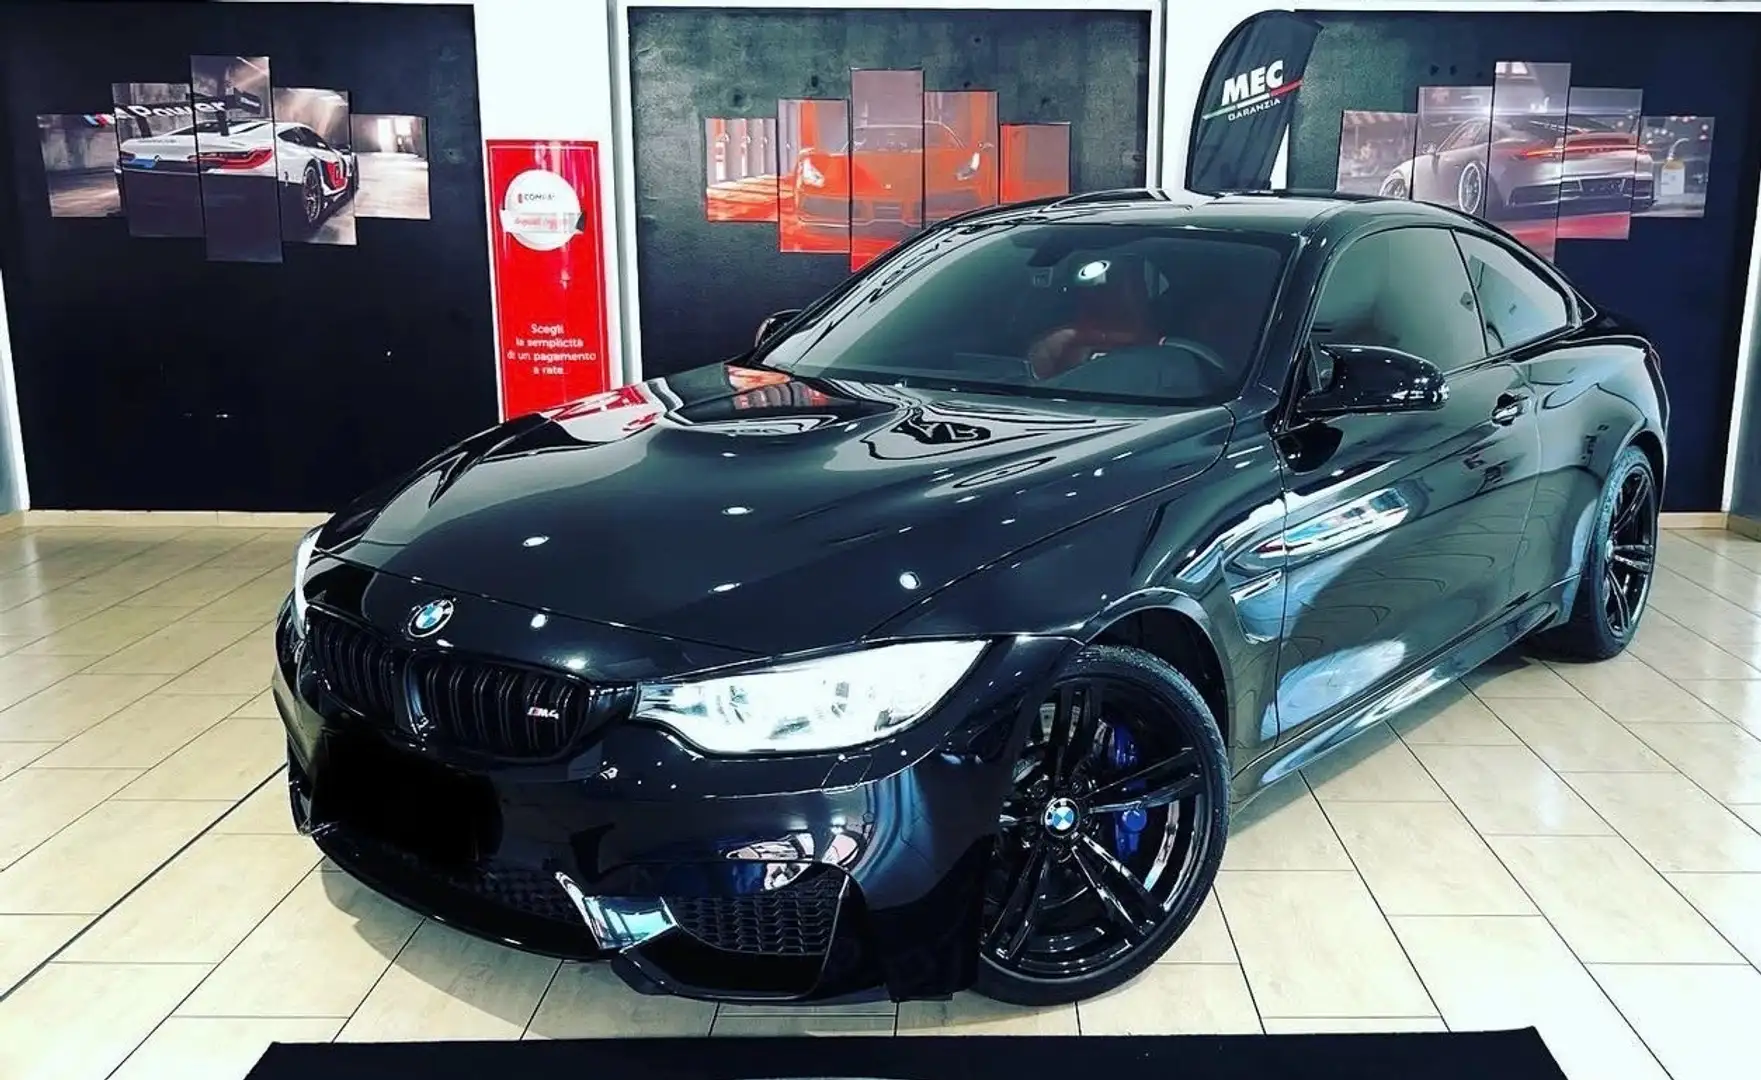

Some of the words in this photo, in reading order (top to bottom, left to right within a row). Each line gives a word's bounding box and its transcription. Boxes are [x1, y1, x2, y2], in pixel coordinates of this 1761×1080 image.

[1221, 60, 1284, 107] MEC
[1228, 98, 1281, 121] GARANZIA
[531, 324, 565, 336] Scegli
[516, 337, 525, 347] la
[507, 350, 516, 360] di
[518, 352, 531, 361] un
[534, 352, 597, 364] pagamento
[533, 367, 540, 375] a
